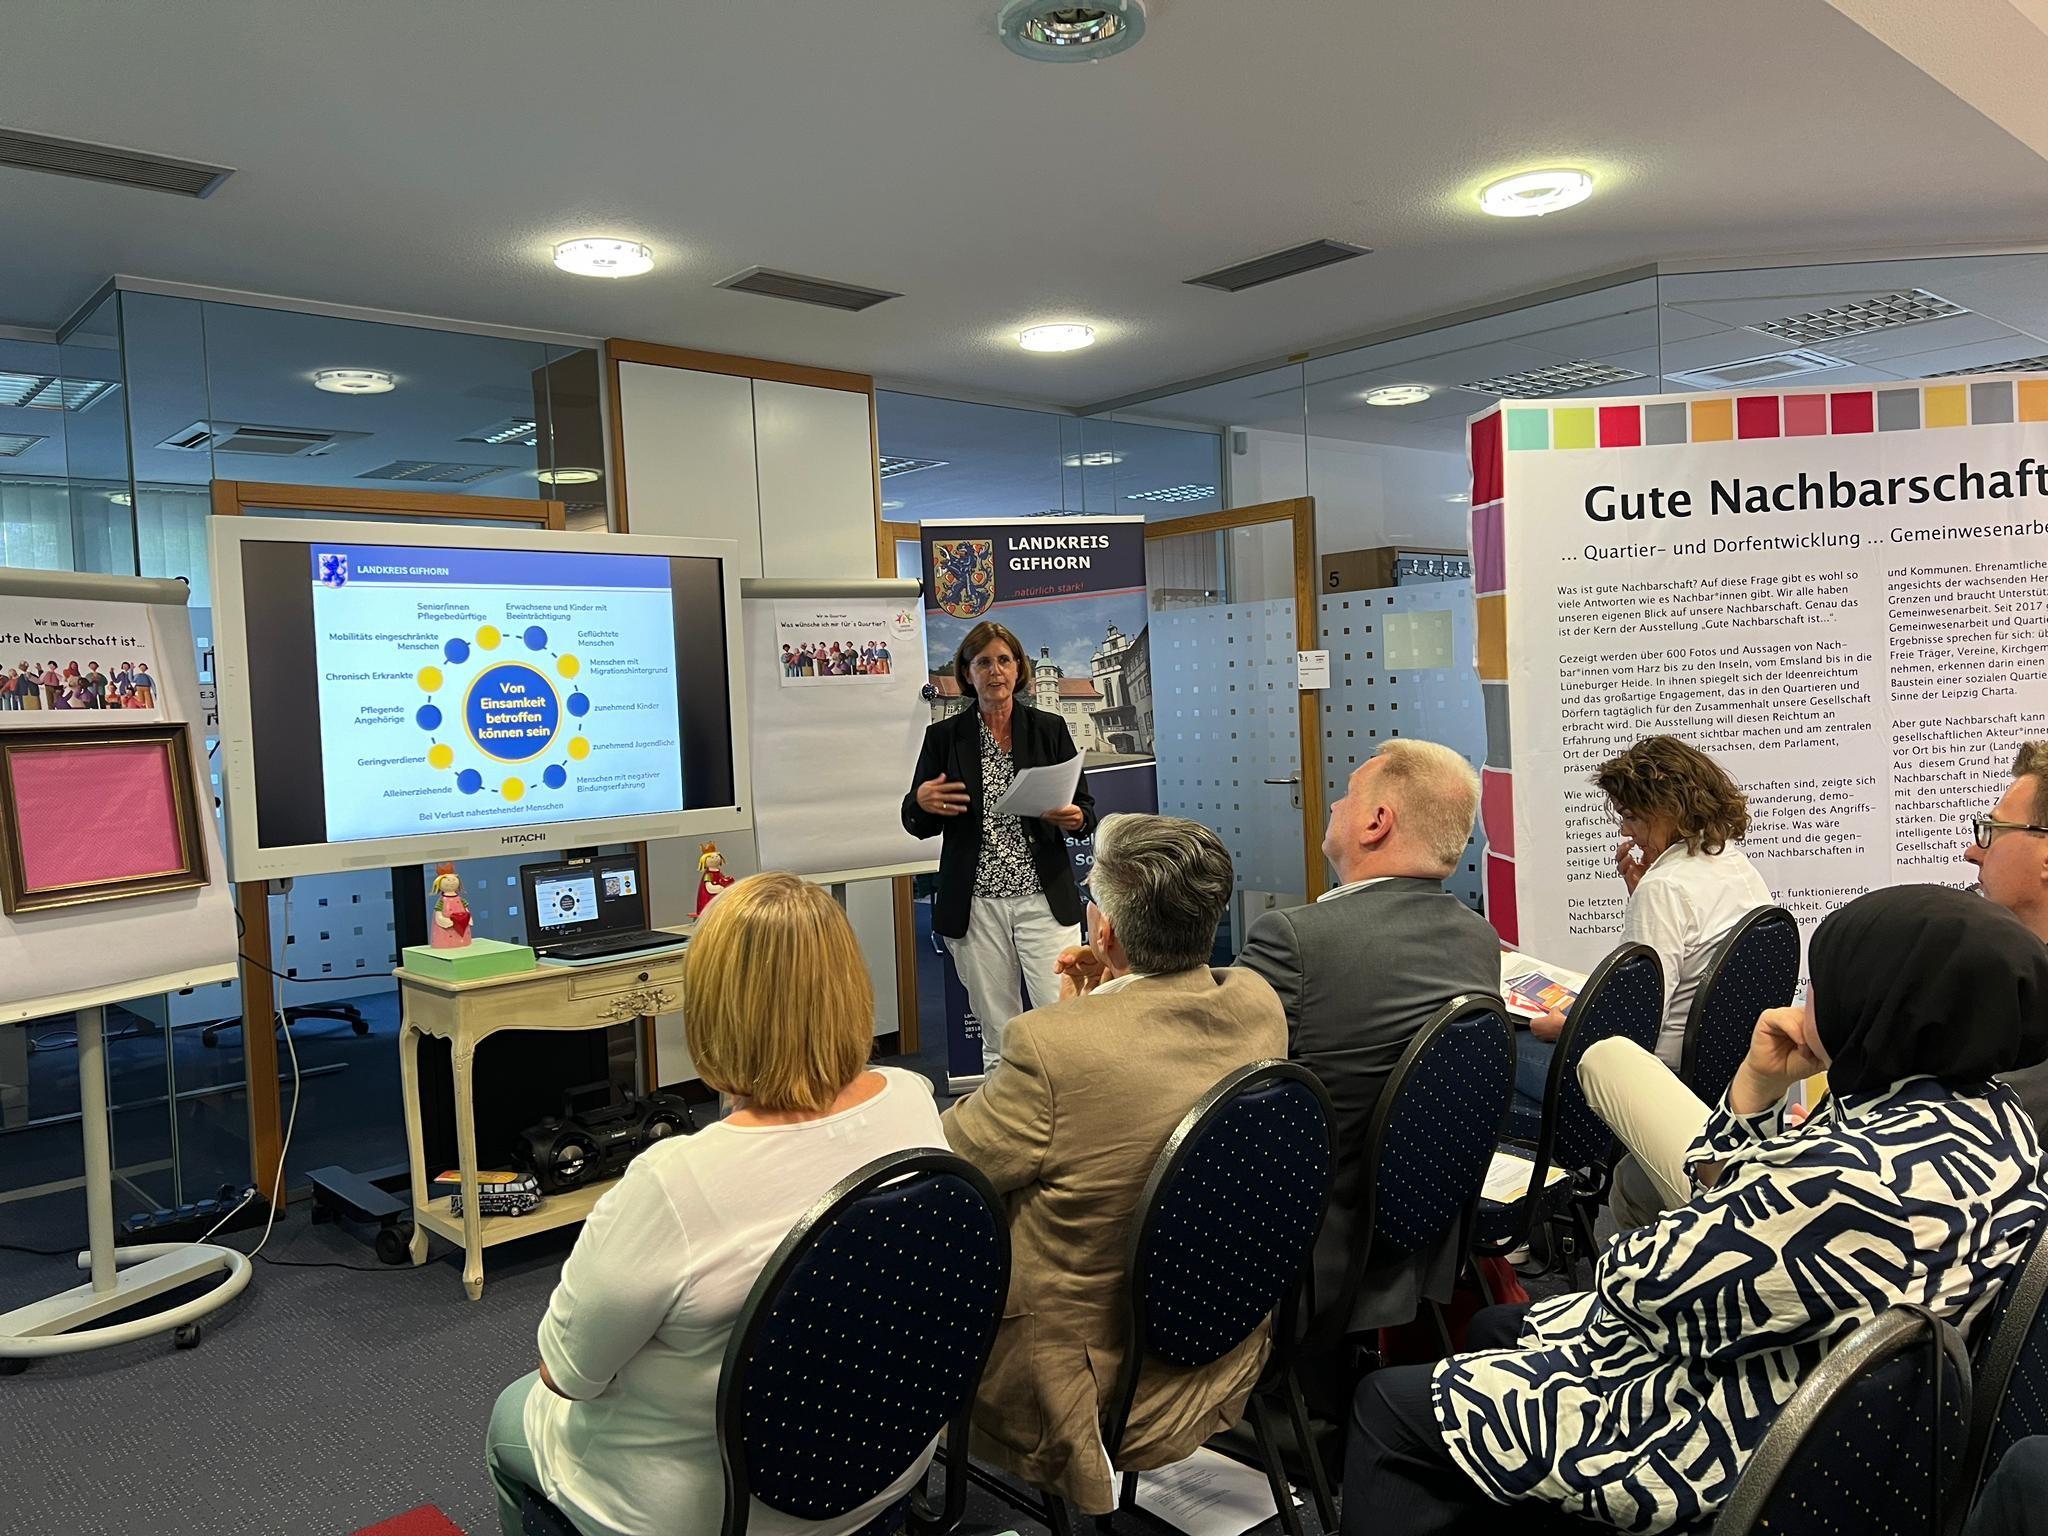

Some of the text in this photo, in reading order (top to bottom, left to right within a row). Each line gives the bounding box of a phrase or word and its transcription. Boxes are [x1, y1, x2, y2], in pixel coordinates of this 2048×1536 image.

[1584, 458, 2048, 521] Gute Nachbarschaft
[1008, 536, 1109, 550] LANDKREIS
[1673, 538, 1705, 555] und
[1713, 531, 1859, 552] Dorfentwicklung
[1010, 556, 1090, 571] GIFHORN
[1887, 559, 2047, 577] und Kommunen. Ehrenamtliche
[357, 566, 449, 576] LANDKREIS GIFHORN
[1329, 572, 1339, 587] 5
[1557, 586, 1577, 594] Was
[1595, 585, 1618, 595] gute
[1621, 579, 1697, 591] Nachbarschaft?
[1700, 577, 1718, 587] Auf
[1720, 577, 1747, 586] diese
[1750, 576, 1778, 586] Frage
[1781, 573, 1801, 585] gibt
[1818, 570, 1842, 581] wohl
[1058, 583, 1084, 593] stark!
[1557, 599, 1580, 608] viele
[1583, 598, 1635, 607] Antworten
[1638, 596, 1655, 604] wie
[1750, 588, 1773, 600] gibt.
[1776, 587, 1793, 597] Wir
[1796, 586, 1813, 596] alle
[1817, 585, 1848, 594] haben
[417, 602, 469, 611] Senior/innen
[1558, 598, 1858, 622] unseren eigenen Blick auf unsere Nachbarschaft. Genau das
[1888, 601, 2042, 618] Gemeinwesenarbeit. Seit 2017
[417, 612, 487, 621] Pflegebedürftige
[506, 613, 571, 621] Beeinträchtigung
[1558, 628, 1570, 636] ist
[1573, 626, 1590, 635] der
[1593, 625, 1616, 634] Kern
[1619, 624, 1636, 633] der
[1639, 621, 1698, 632] Ausstellung
[1732, 614, 1804, 627] Nachbarschaft
[0, 633, 20, 643] ute
[24, 633, 117, 646] Nachbarschaft
[375, 633, 439, 641] eingeschränkte
[1558, 654, 1597, 664] Gezeigt
[1600, 651, 1637, 661] werden
[1640, 650, 1663, 659] über
[1666, 648, 1686, 658] 600
[1689, 648, 1716, 656] Fotos
[1720, 645, 1739, 655] und
[1742, 645, 1790, 654] Aussagen
[1637, 664, 1660, 673] Harz
[1663, 663, 1678, 672] bis
[1696, 661, 1715, 670] den
[1719, 659, 1752, 669] Inseln,
[1780, 654, 1822, 666] Emsland
[1825, 654, 1840, 663] bis
[1856, 652, 1872, 661] die
[1890, 658, 2044, 673] nehmen, erkennen darin einen
[590, 667, 668, 676] Migrationshintergrund
[500, 682, 525, 693] Von
[1891, 686, 2016, 701] Sinne der Leipzig Charta.
[480, 697, 546, 710] Einsamkeit
[354, 716, 405, 725] Angehörige
[486, 712, 542, 724] betroffen
[1891, 712, 2045, 729] Aber gute Nachbarschaft kann
[478, 726, 550, 739] können sein
[635, 740, 675, 749] Jugendliche
[358, 756, 425, 767] Geringverdiener
[628, 772, 660, 781] negativer
[383, 787, 452, 798] Alleinerziehende
[577, 782, 645, 792] Bindungserfahrung
[435, 811, 464, 819] Verlust
[466, 805, 524, 816] nahestehender
[526, 803, 563, 812] Menschen
[502, 833, 546, 844] HITACHI
